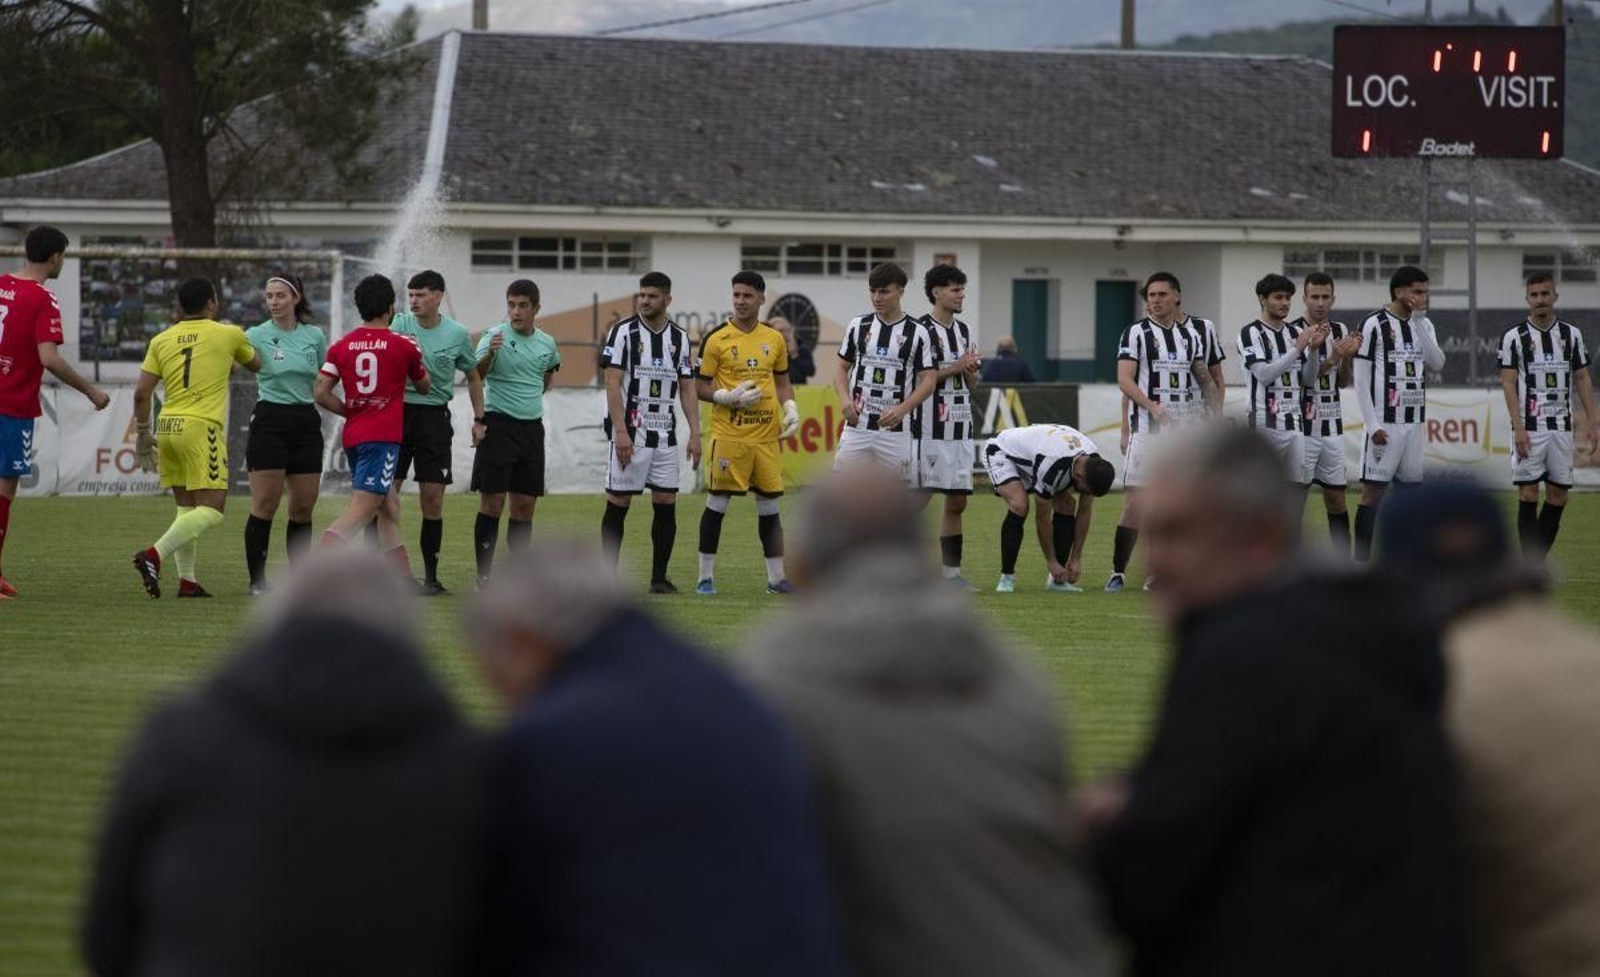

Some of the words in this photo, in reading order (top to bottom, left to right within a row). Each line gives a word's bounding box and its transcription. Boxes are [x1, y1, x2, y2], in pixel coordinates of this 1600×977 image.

[1346, 74, 1416, 107] LOC.
[1478, 76, 1558, 107] VISIT.
[1418, 138, 1475, 155] Bodet
[177, 333, 198, 344] ELOY
[348, 338, 388, 350] GUILLÁN
[180, 347, 193, 389] 1
[355, 351, 377, 394] 9
[96, 448, 158, 474] FO
[78, 480, 127, 496] empresa
